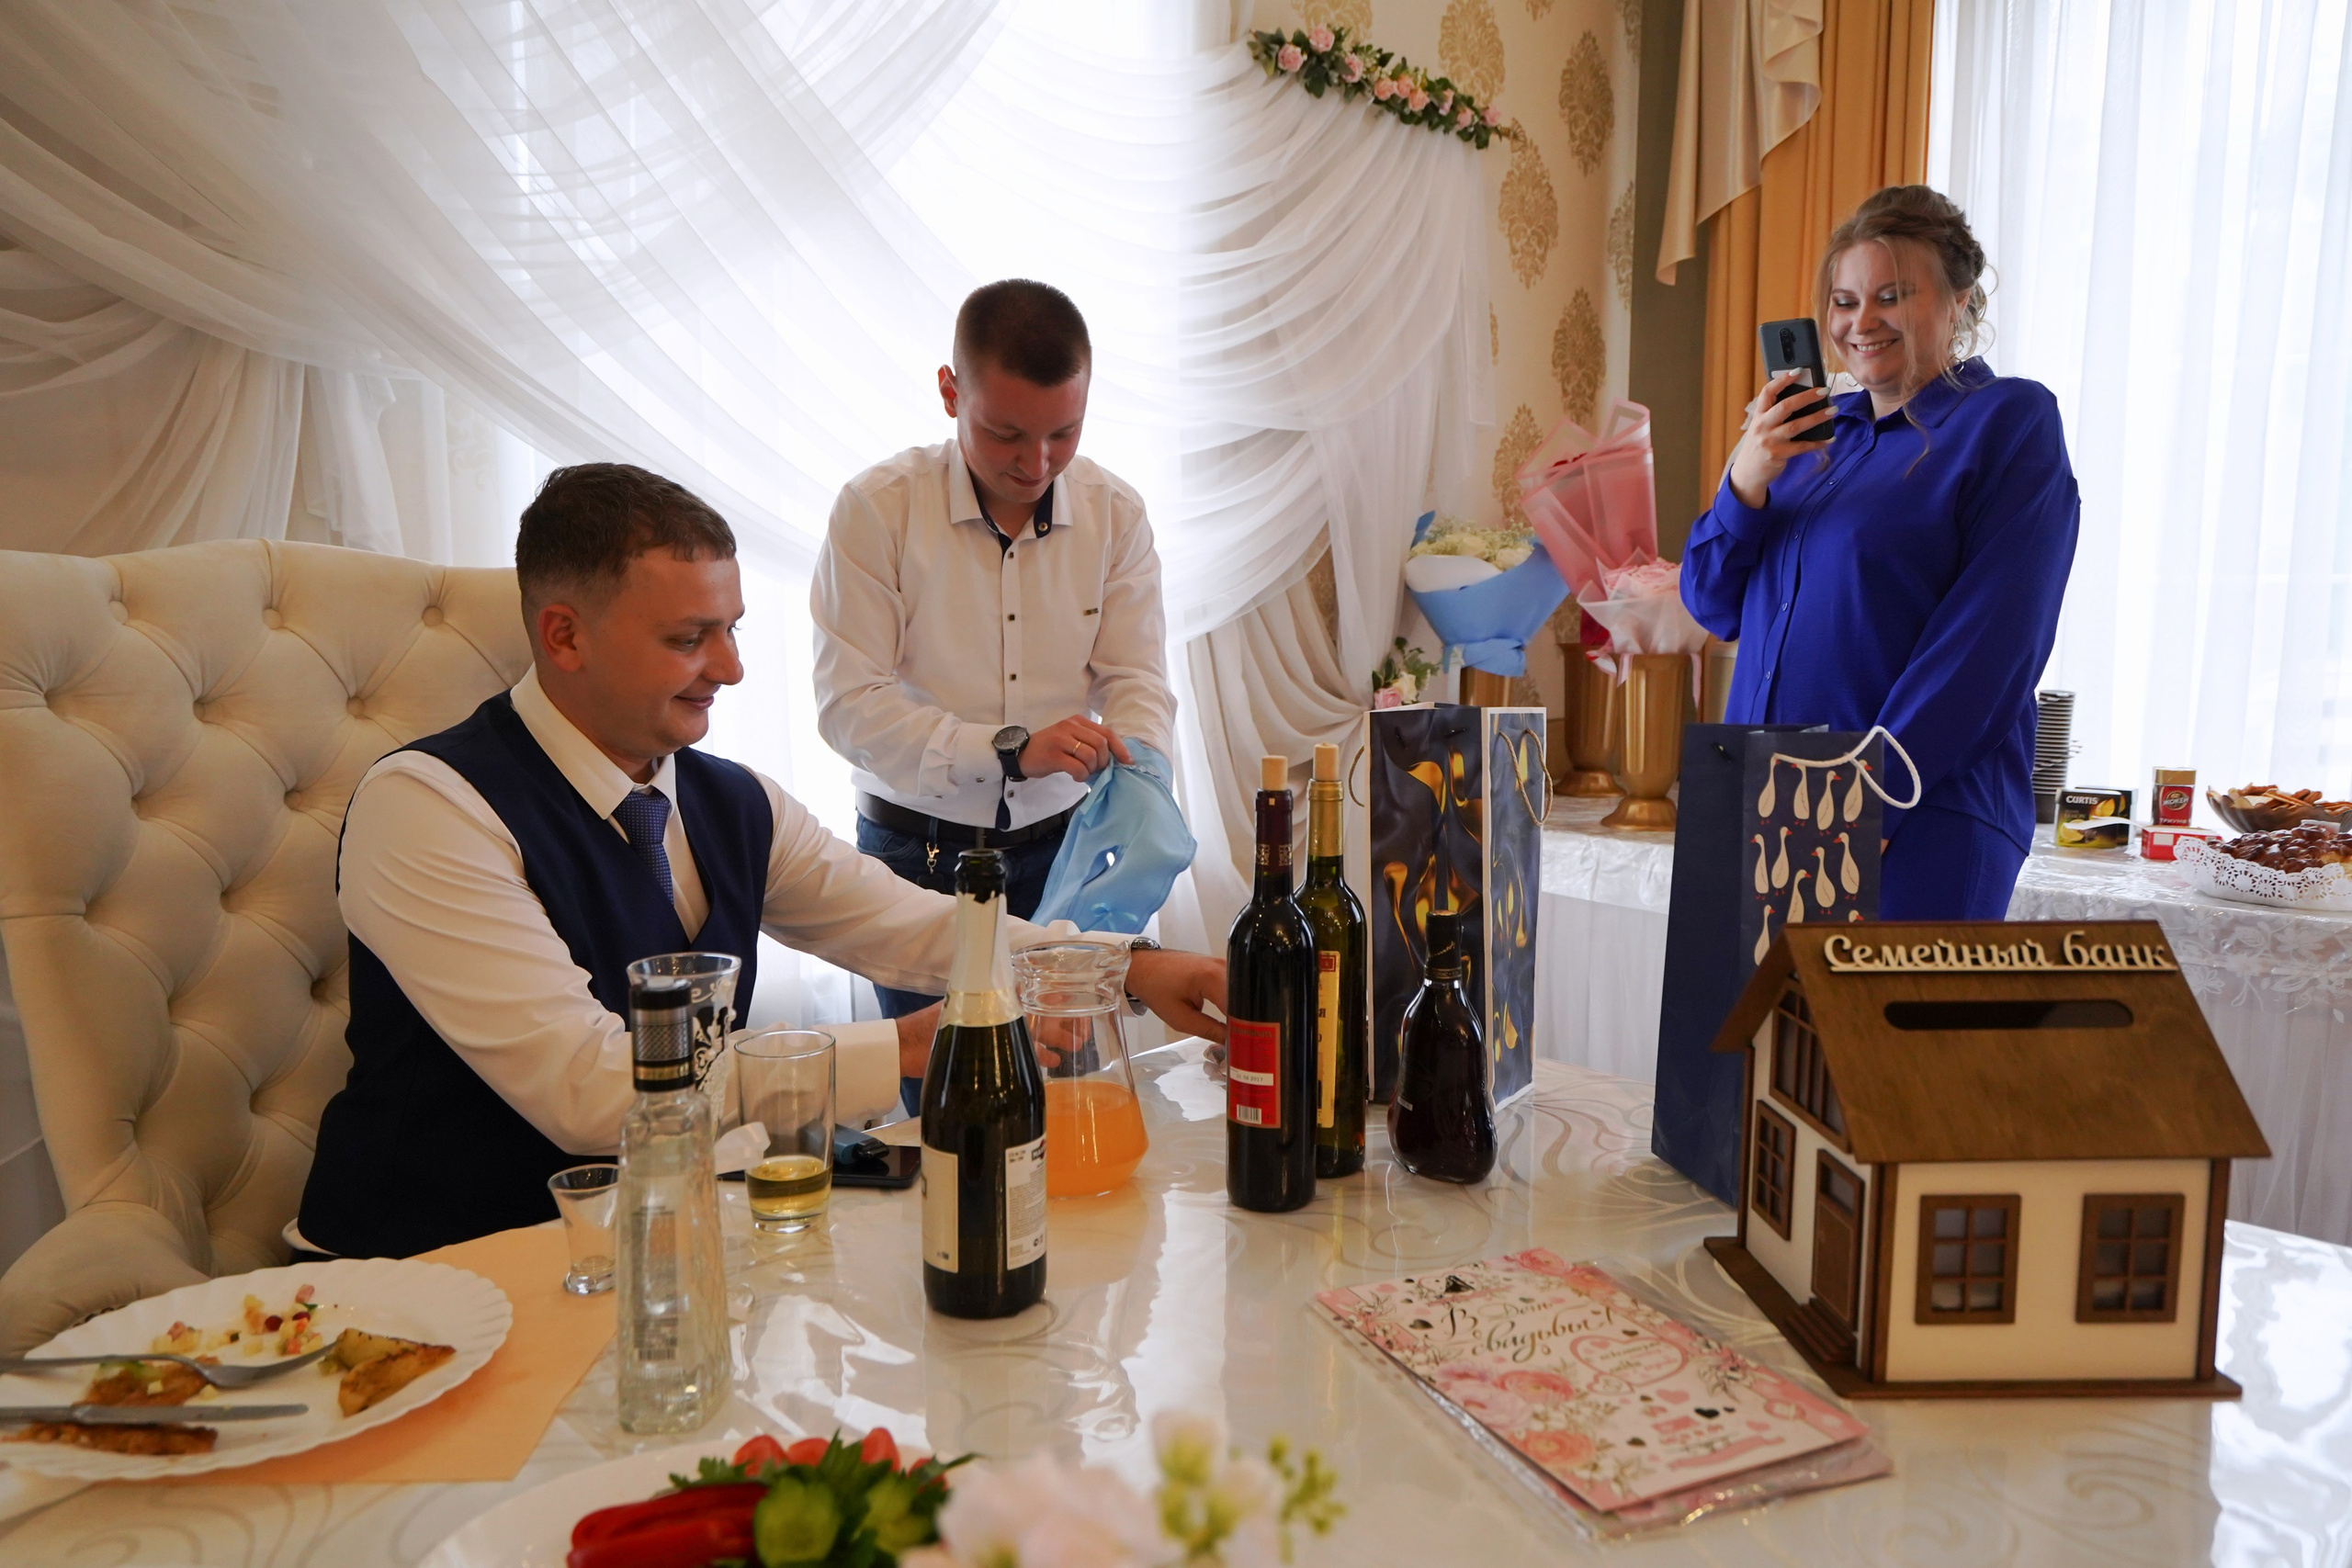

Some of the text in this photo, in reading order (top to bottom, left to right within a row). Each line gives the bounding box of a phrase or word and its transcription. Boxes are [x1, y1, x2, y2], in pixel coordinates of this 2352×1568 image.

[2065, 795, 2098, 805] CURTIS
[2162, 795, 2189, 806] ЖОКЕЙ
[1824, 931, 2173, 970] Семейный банк
